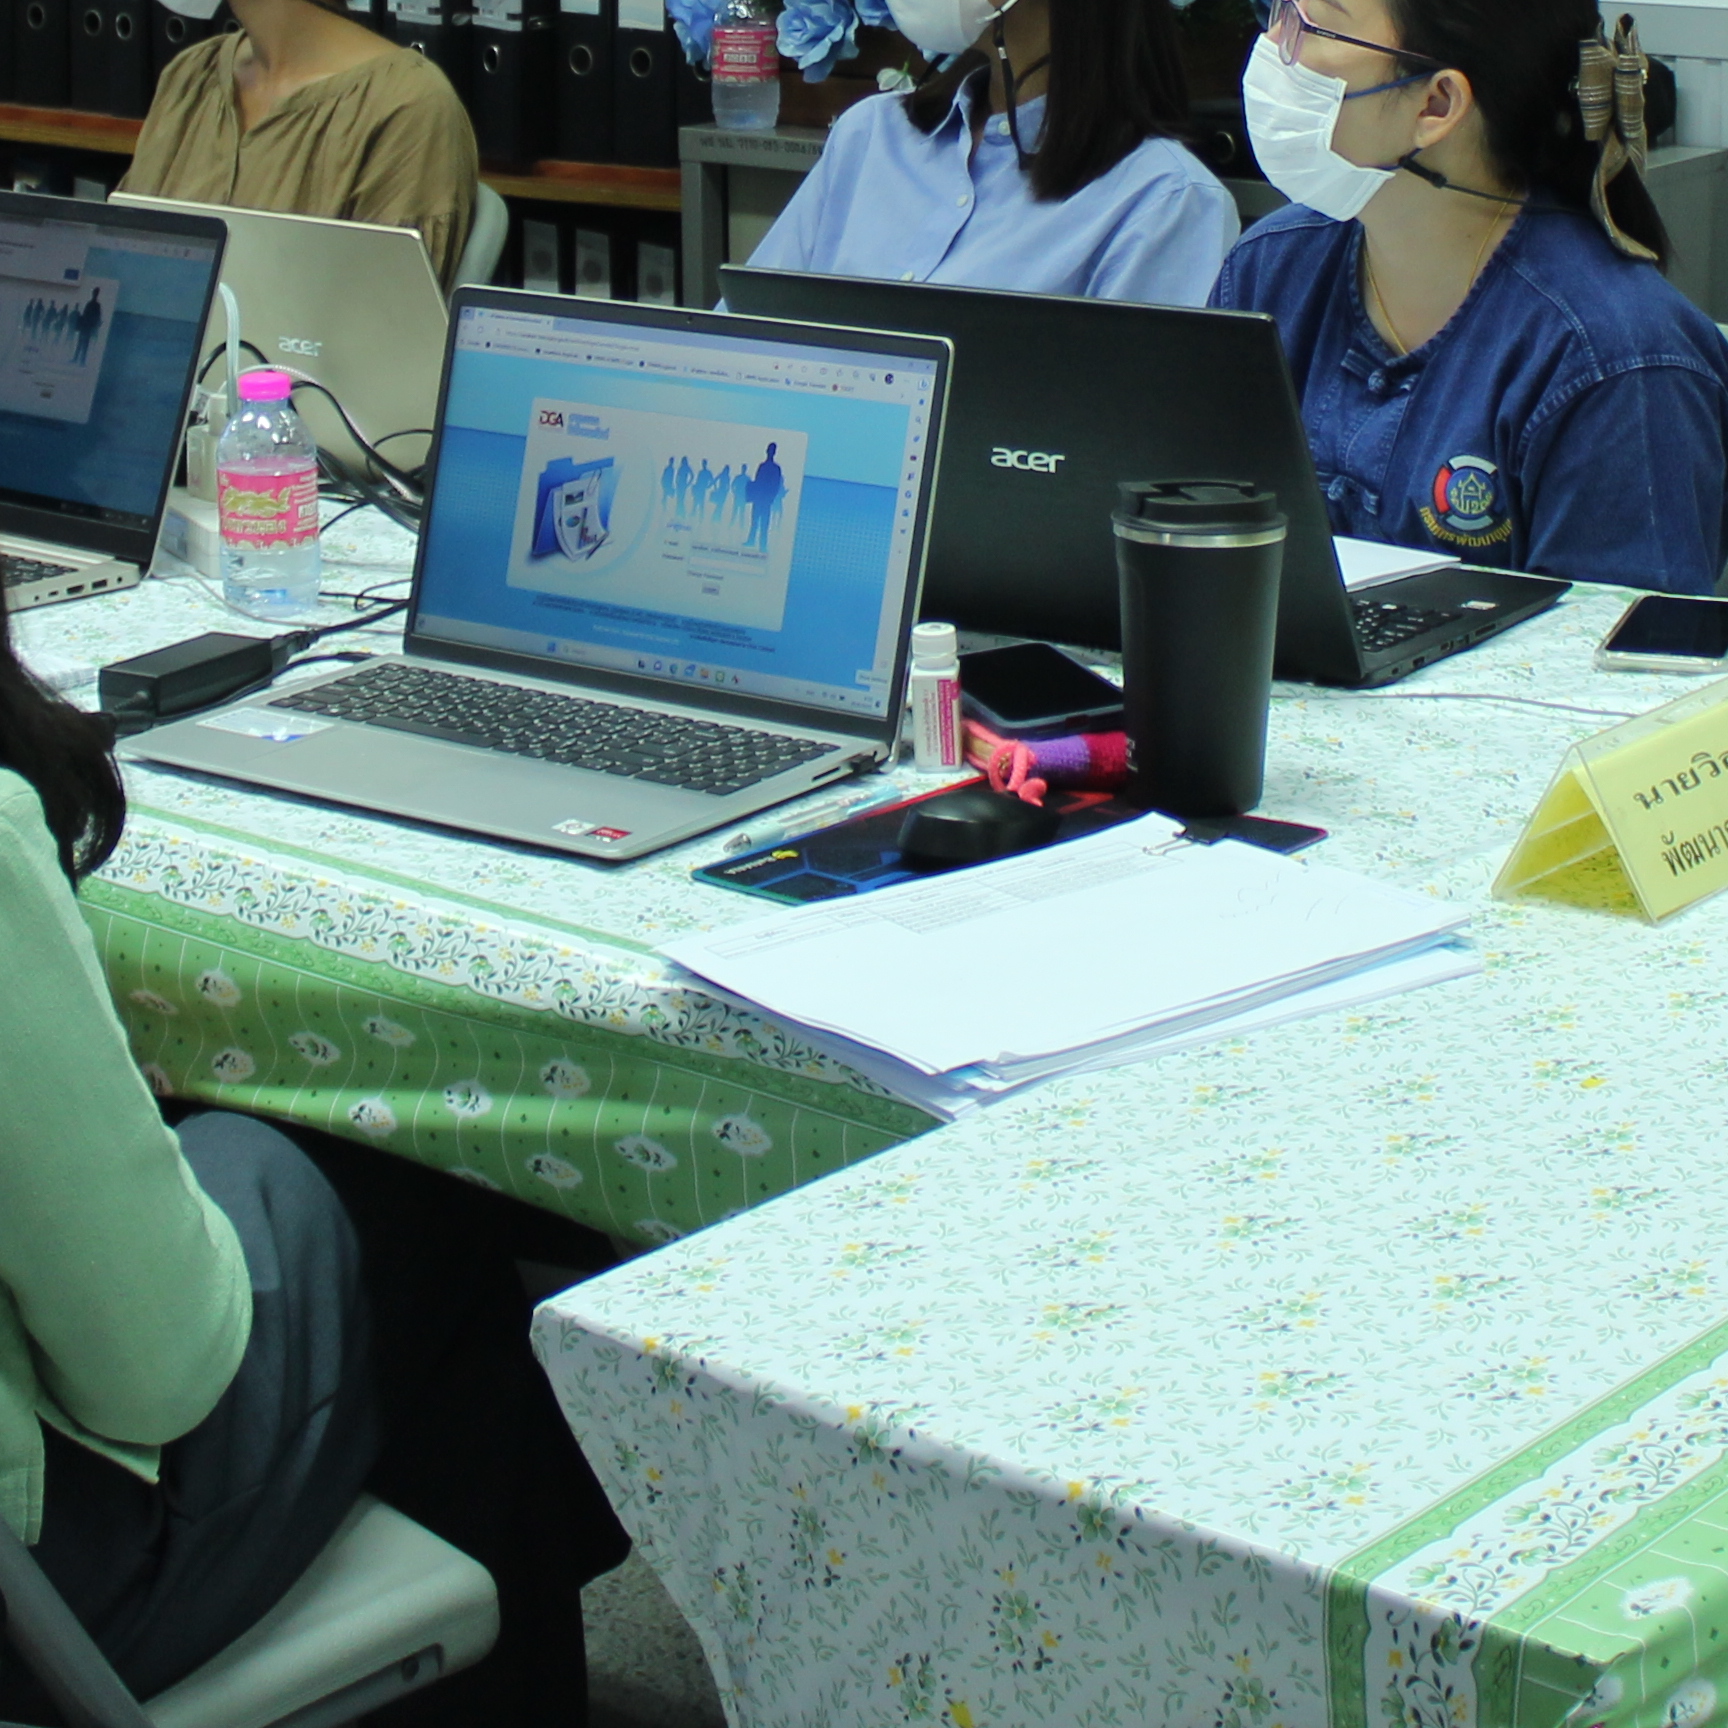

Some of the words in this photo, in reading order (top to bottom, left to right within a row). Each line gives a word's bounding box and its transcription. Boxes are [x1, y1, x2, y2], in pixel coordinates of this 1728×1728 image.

[278, 336, 323, 357] acer
[539, 410, 564, 428] DGA
[991, 447, 1066, 473] acer
